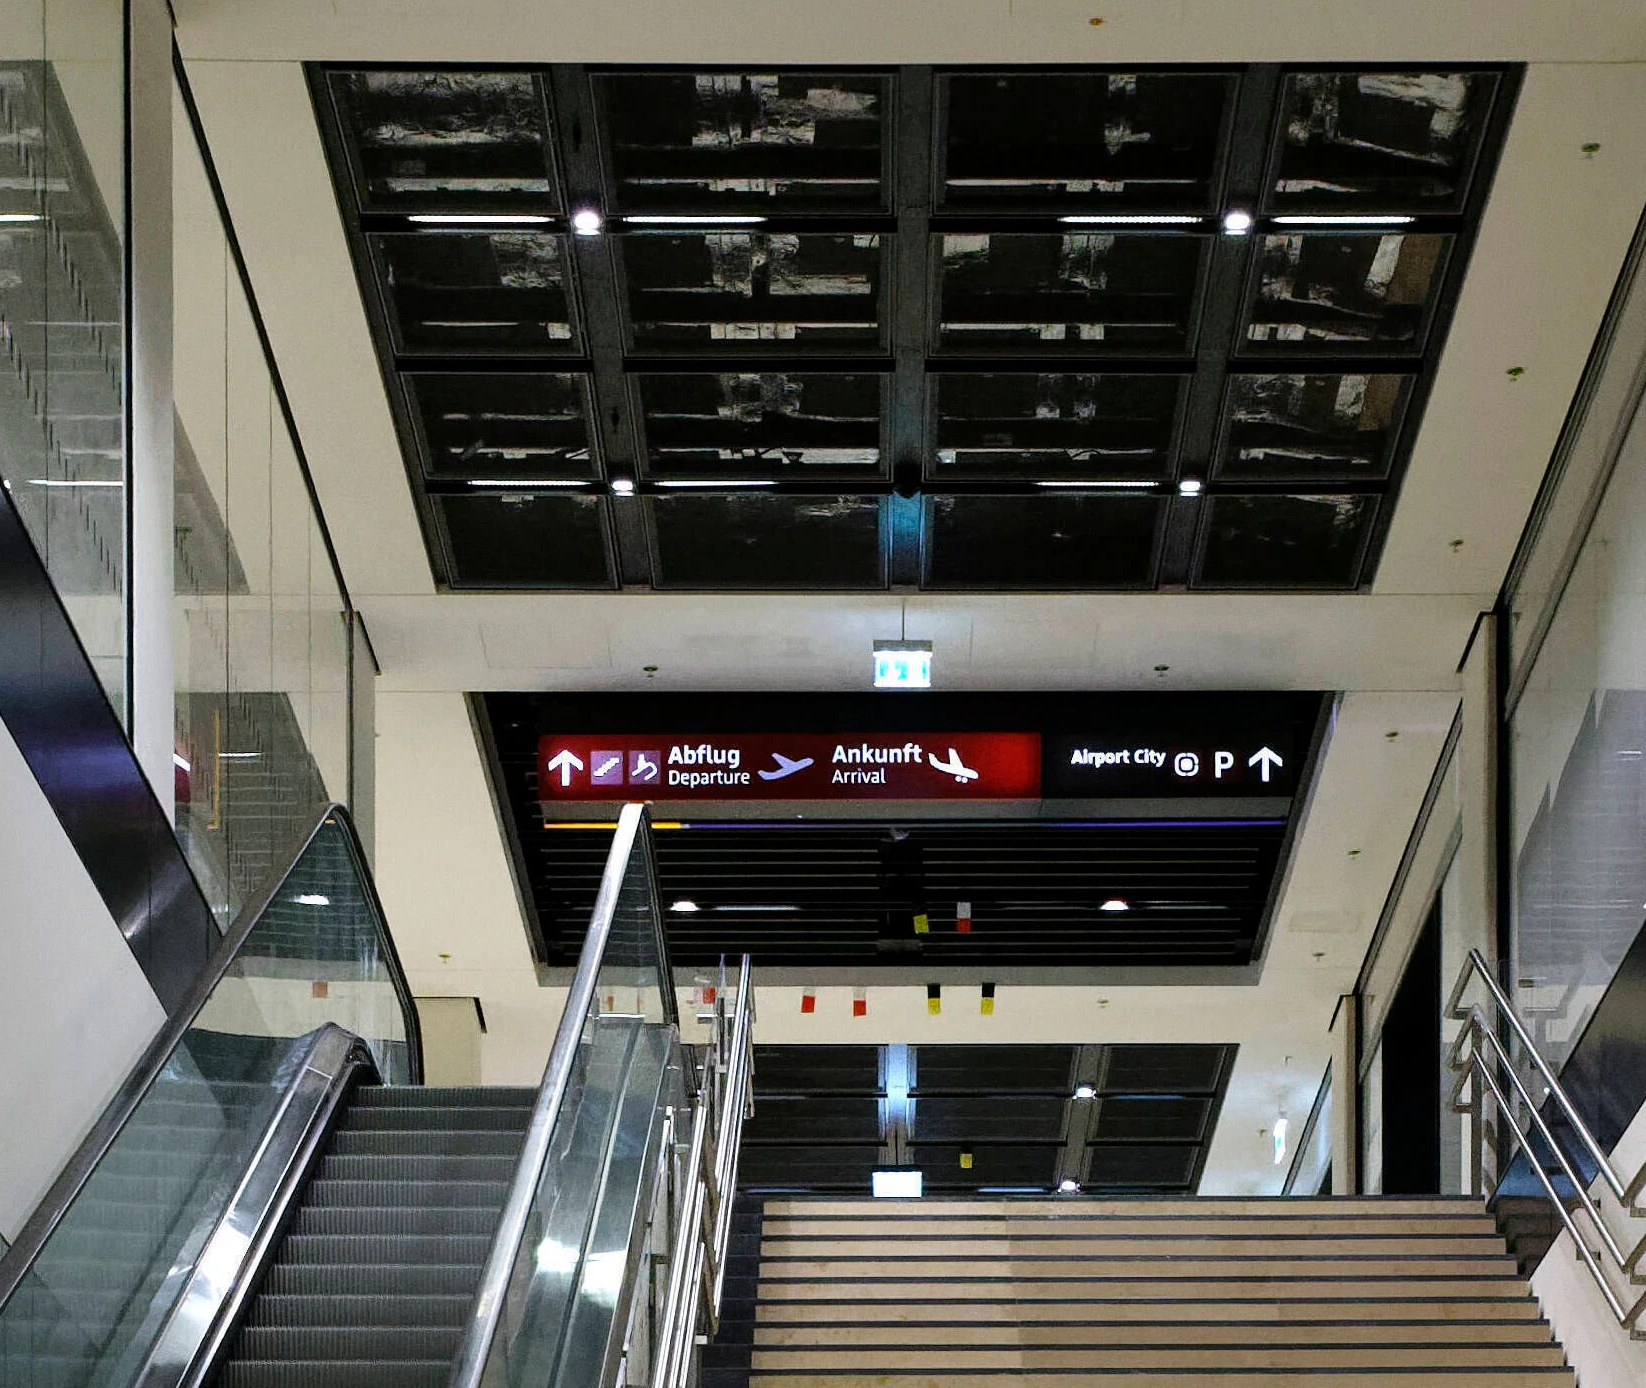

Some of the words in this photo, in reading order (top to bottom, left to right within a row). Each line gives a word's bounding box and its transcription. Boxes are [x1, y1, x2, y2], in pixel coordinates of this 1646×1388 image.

[667, 744, 741, 769] Abflug
[831, 742, 923, 764] Ankunft
[1070, 748, 1131, 769] Airport
[1133, 748, 1167, 768] City
[1214, 751, 1235, 779] P
[667, 769, 751, 789] Departure
[831, 767, 887, 785] Arrival
